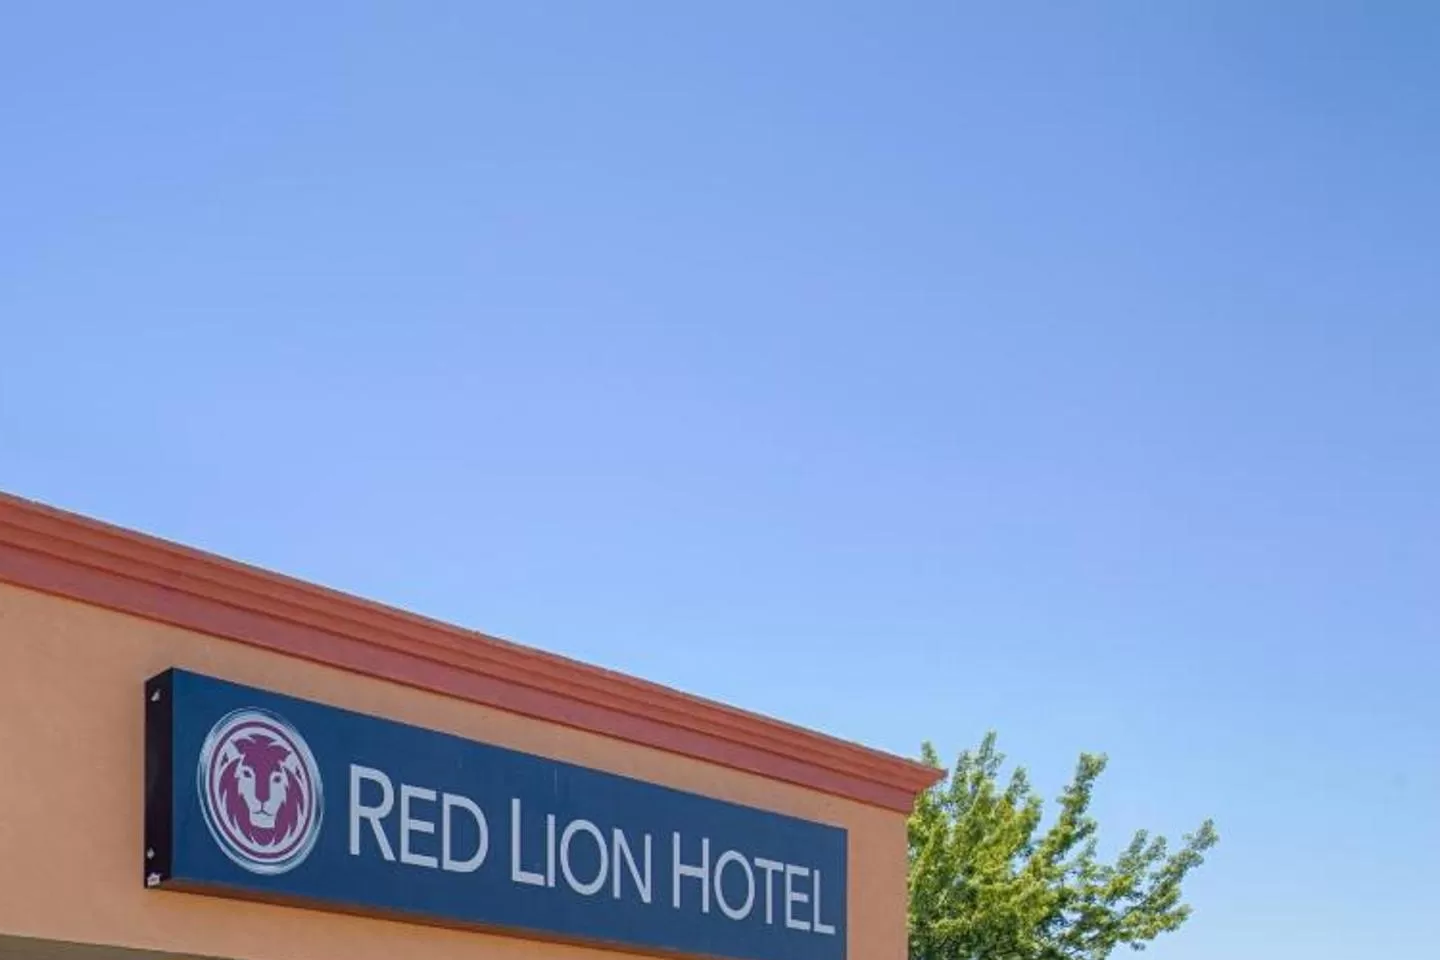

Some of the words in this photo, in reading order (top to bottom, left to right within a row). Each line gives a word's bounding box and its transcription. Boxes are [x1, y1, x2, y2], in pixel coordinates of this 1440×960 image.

[349, 763, 489, 873] RED
[512, 797, 652, 904] LION
[673, 831, 836, 935] HOTEL
